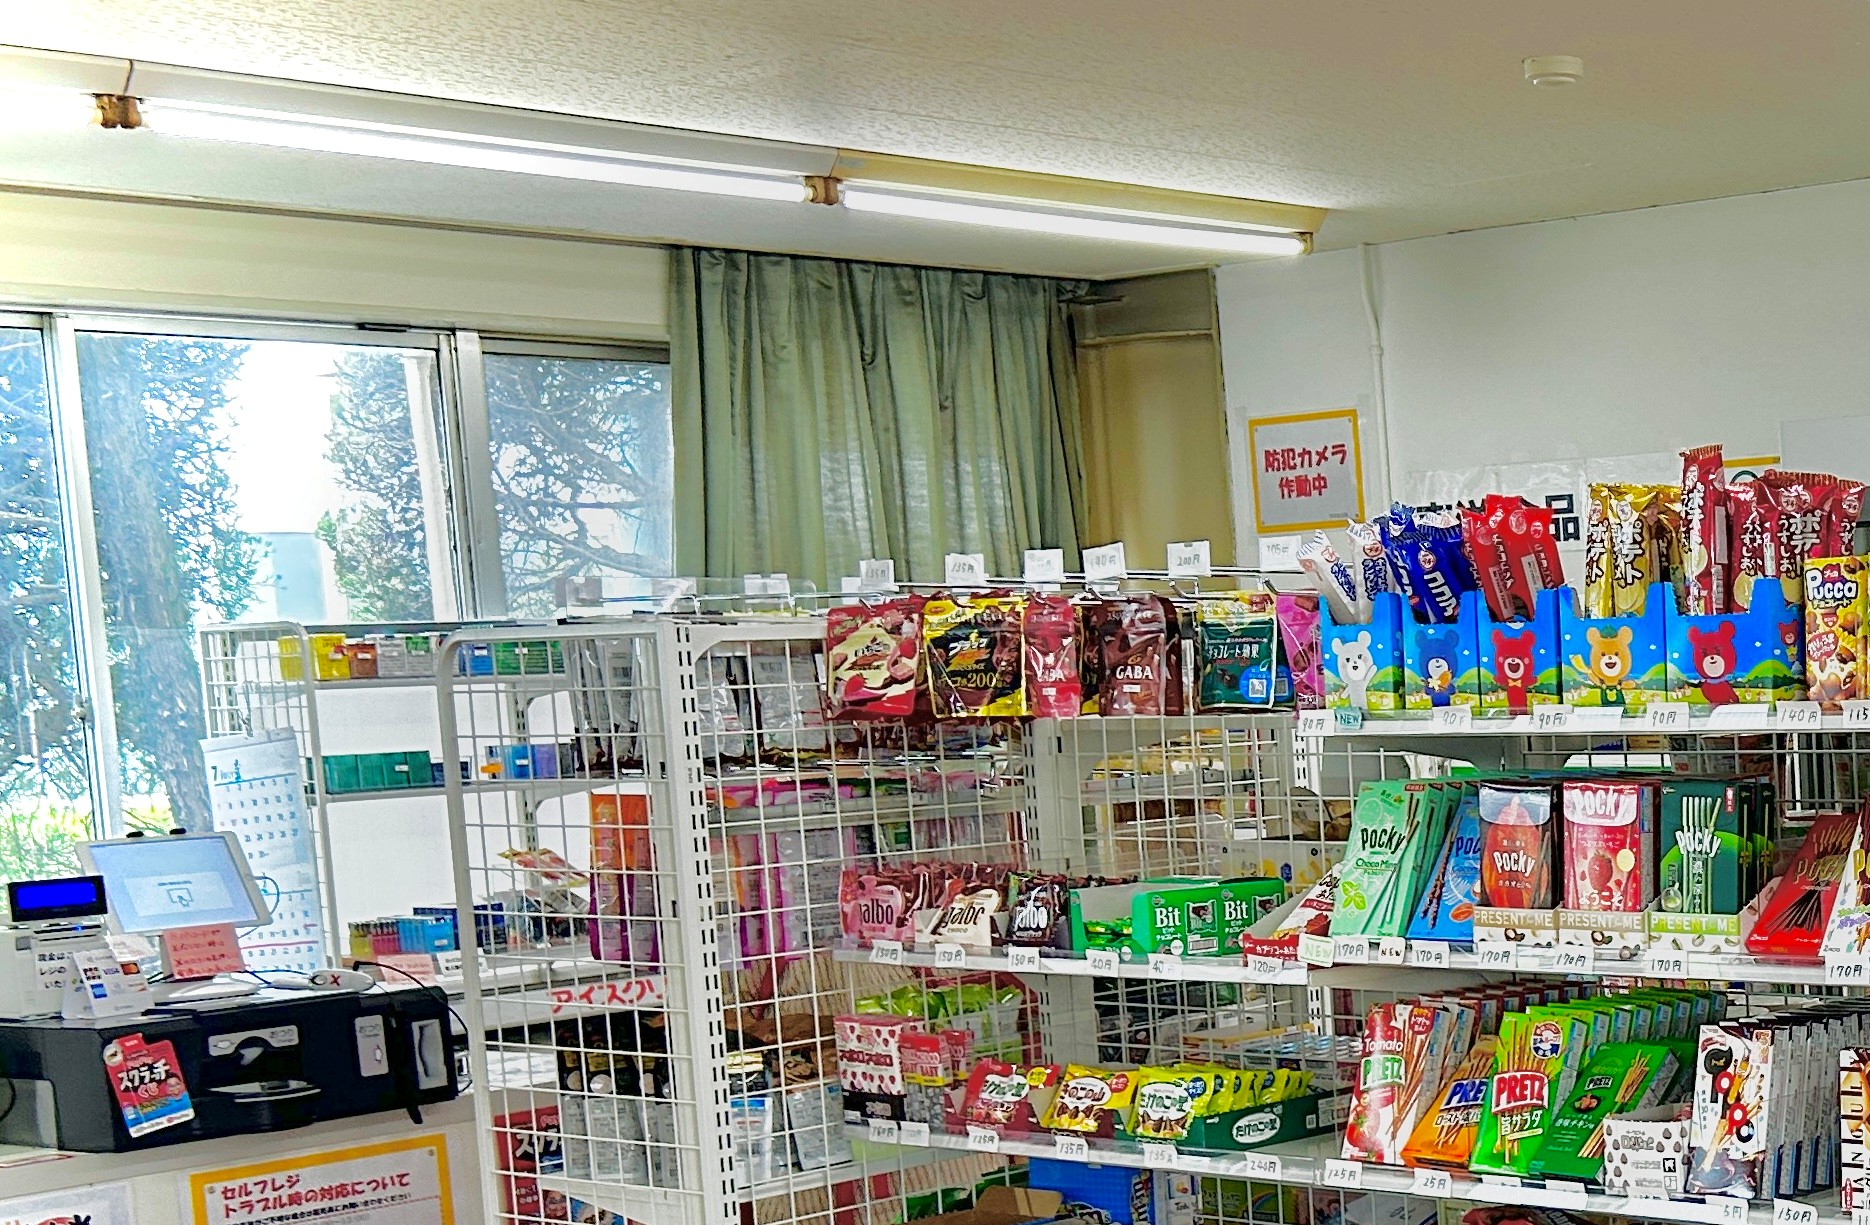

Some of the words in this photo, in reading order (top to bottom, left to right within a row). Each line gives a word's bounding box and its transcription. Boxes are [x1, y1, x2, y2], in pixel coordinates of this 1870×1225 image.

[1264, 443, 1348, 473] 防犯カメラ
[1278, 473, 1328, 498] 作動中
[1115, 665, 1153, 680] GABA
[1341, 713, 1360, 726] NEW
[1652, 710, 1678, 725] 90円
[1782, 709, 1818, 723] 140円
[1155, 907, 1182, 928] Bit
[1223, 899, 1248, 921] Bit
[1474, 909, 1525, 927] PRESENT
[1532, 911, 1553, 928] ME
[1559, 909, 1613, 928] PRESENT
[1624, 911, 1641, 929] ME
[1305, 943, 1331, 958] NEW
[1338, 944, 1364, 957] 170円
[1381, 949, 1403, 958] NEW
[1417, 950, 1443, 963] 170円
[1481, 950, 1511, 964] 170円
[1012, 954, 1036, 966] 150円
[1091, 959, 1112, 971] 40円
[1556, 954, 1586, 968] 170円
[1651, 959, 1682, 973] 170円
[1830, 965, 1862, 979] 170円
[1363, 1038, 1403, 1052] Tomato
[117, 1059, 170, 1090] スクラッチ
[1493, 1074, 1548, 1104] PRETZ
[1061, 1140, 1086, 1155] 135円
[1328, 1168, 1356, 1181] 125円
[221, 1173, 301, 1201] セルフレジ
[223, 1172, 411, 1219] トラブル時の対応について
[1778, 1208, 1812, 1223] 150円
